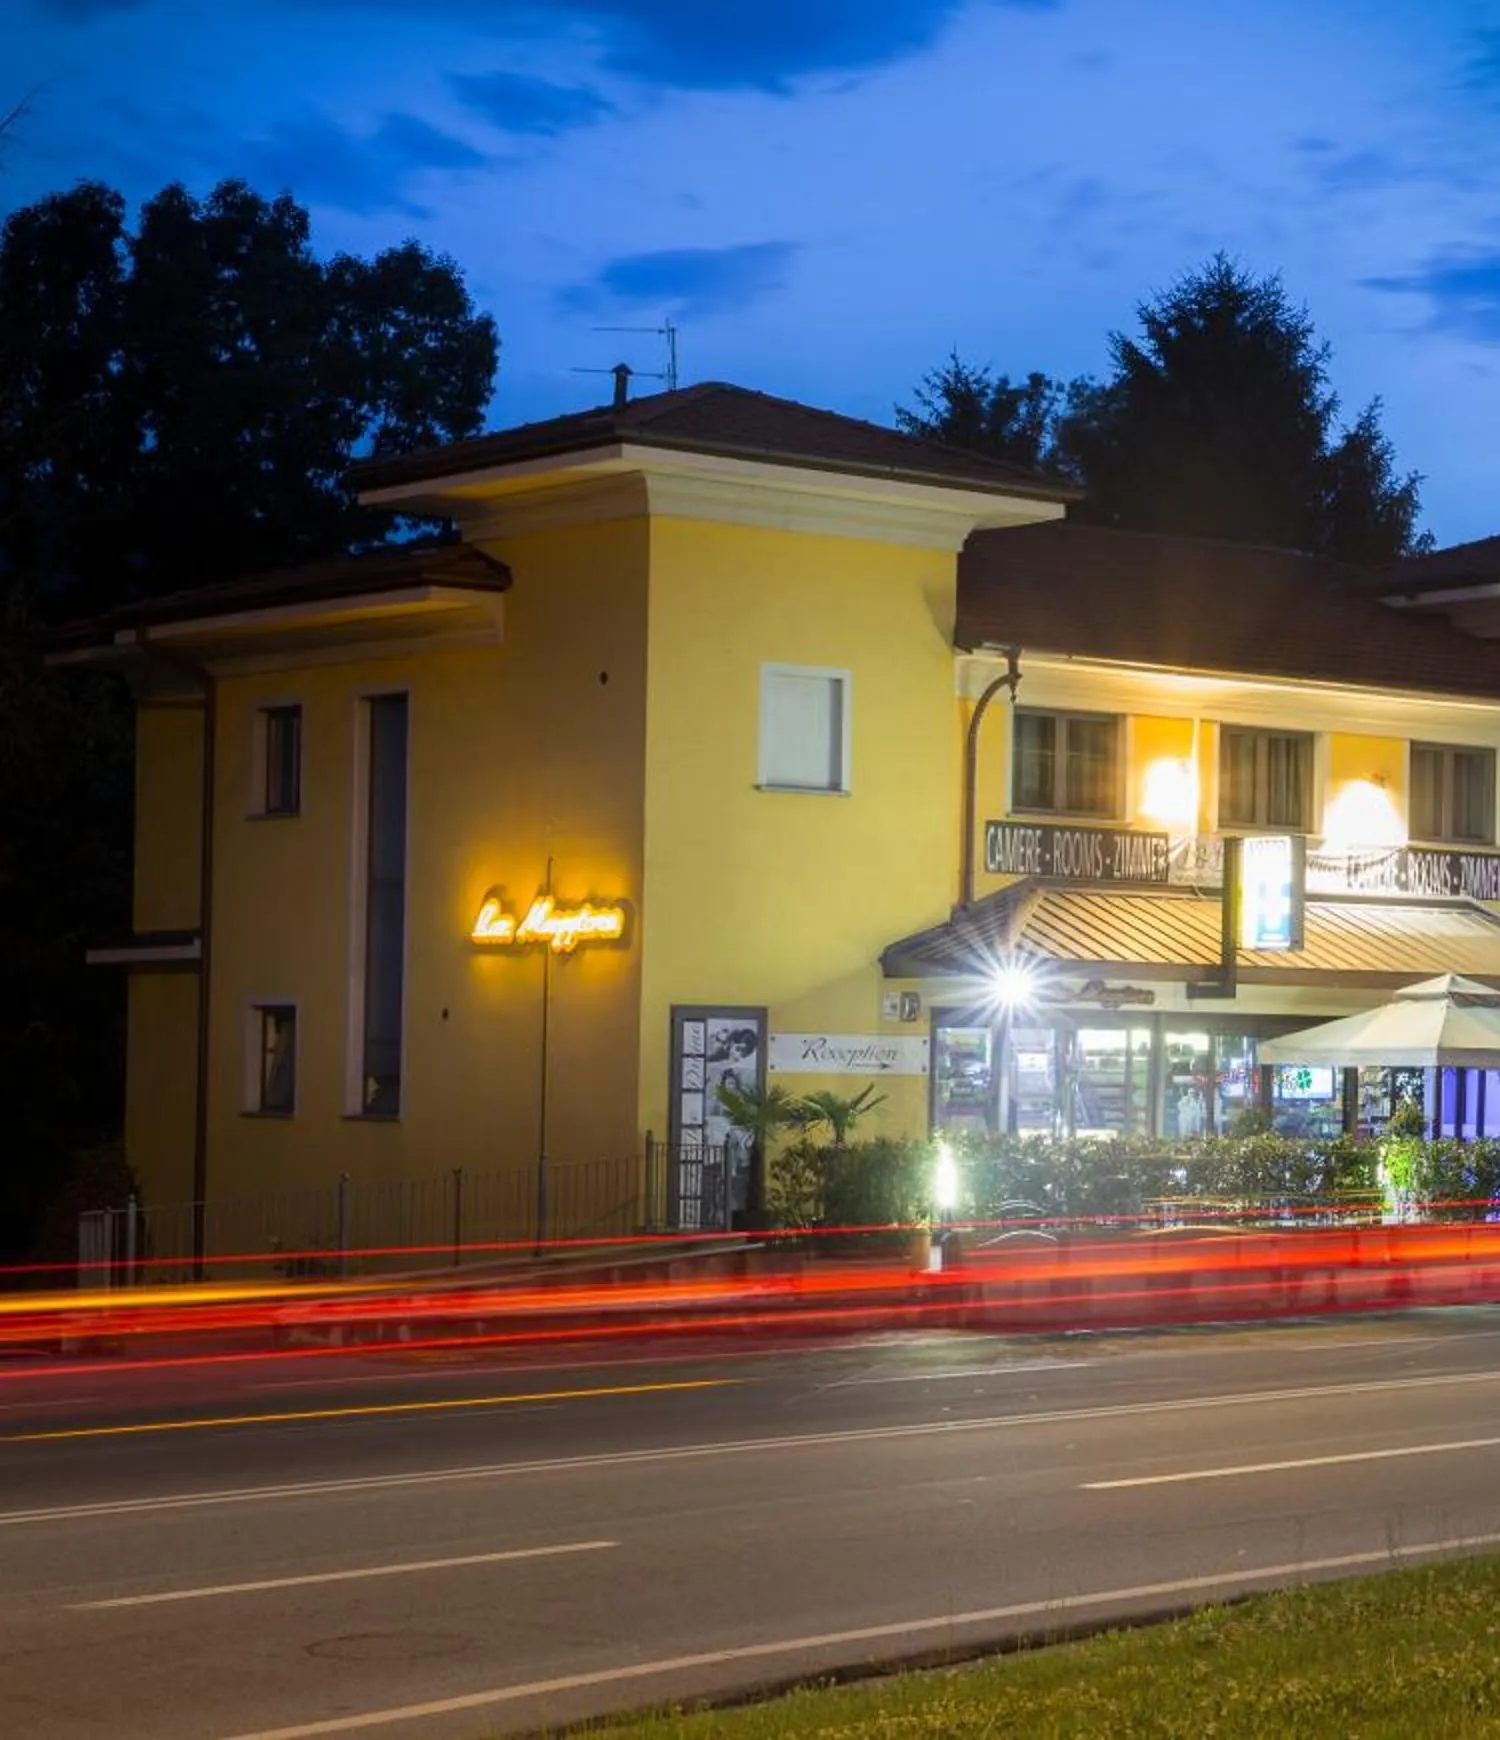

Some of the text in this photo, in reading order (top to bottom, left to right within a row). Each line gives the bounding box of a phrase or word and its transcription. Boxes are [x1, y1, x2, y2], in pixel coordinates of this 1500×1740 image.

[987, 823, 1043, 874] CAMERE
[1053, 830, 1103, 878] ROOMS
[1113, 834, 1169, 882] ZIMMER
[1408, 851, 1451, 896] ROOMS
[472, 899, 513, 942] La
[801, 1037, 898, 1068] Reception
